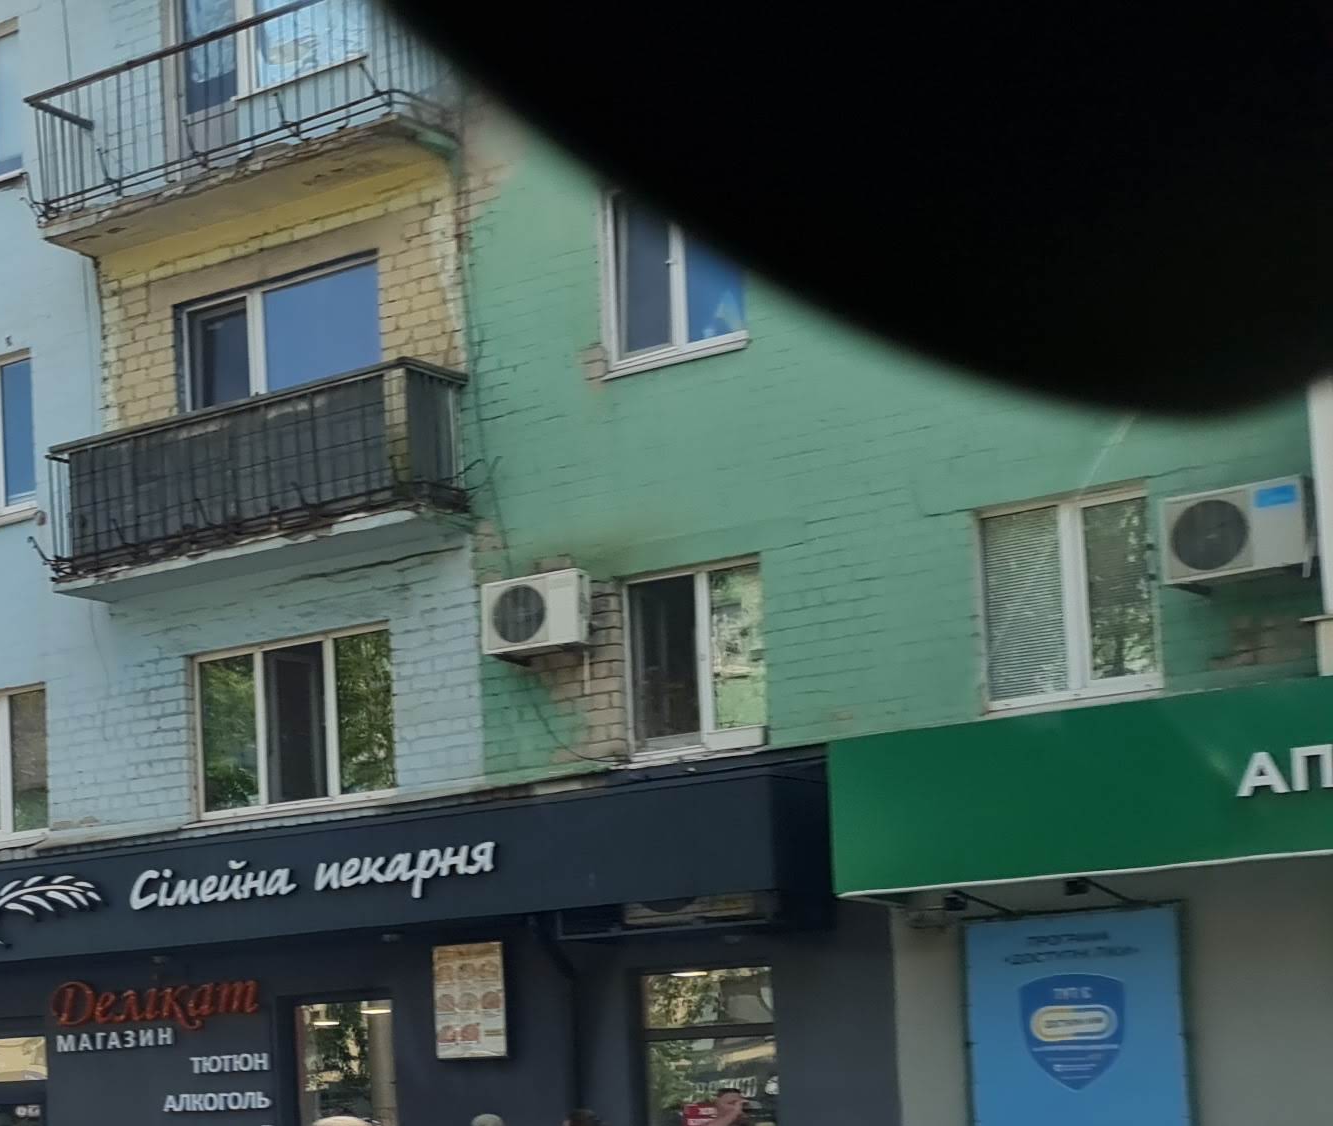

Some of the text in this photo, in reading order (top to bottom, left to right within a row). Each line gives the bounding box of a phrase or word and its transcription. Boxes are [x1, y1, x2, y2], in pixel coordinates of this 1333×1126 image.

[129, 841, 495, 910] Сімейна пекарня
[50, 979, 261, 1030] Делікат
[56, 1027, 174, 1052] МАГАЗИН
[189, 1053, 271, 1074] ТЮТЮН
[163, 1091, 272, 1112] АЛКОГОЛЬ
